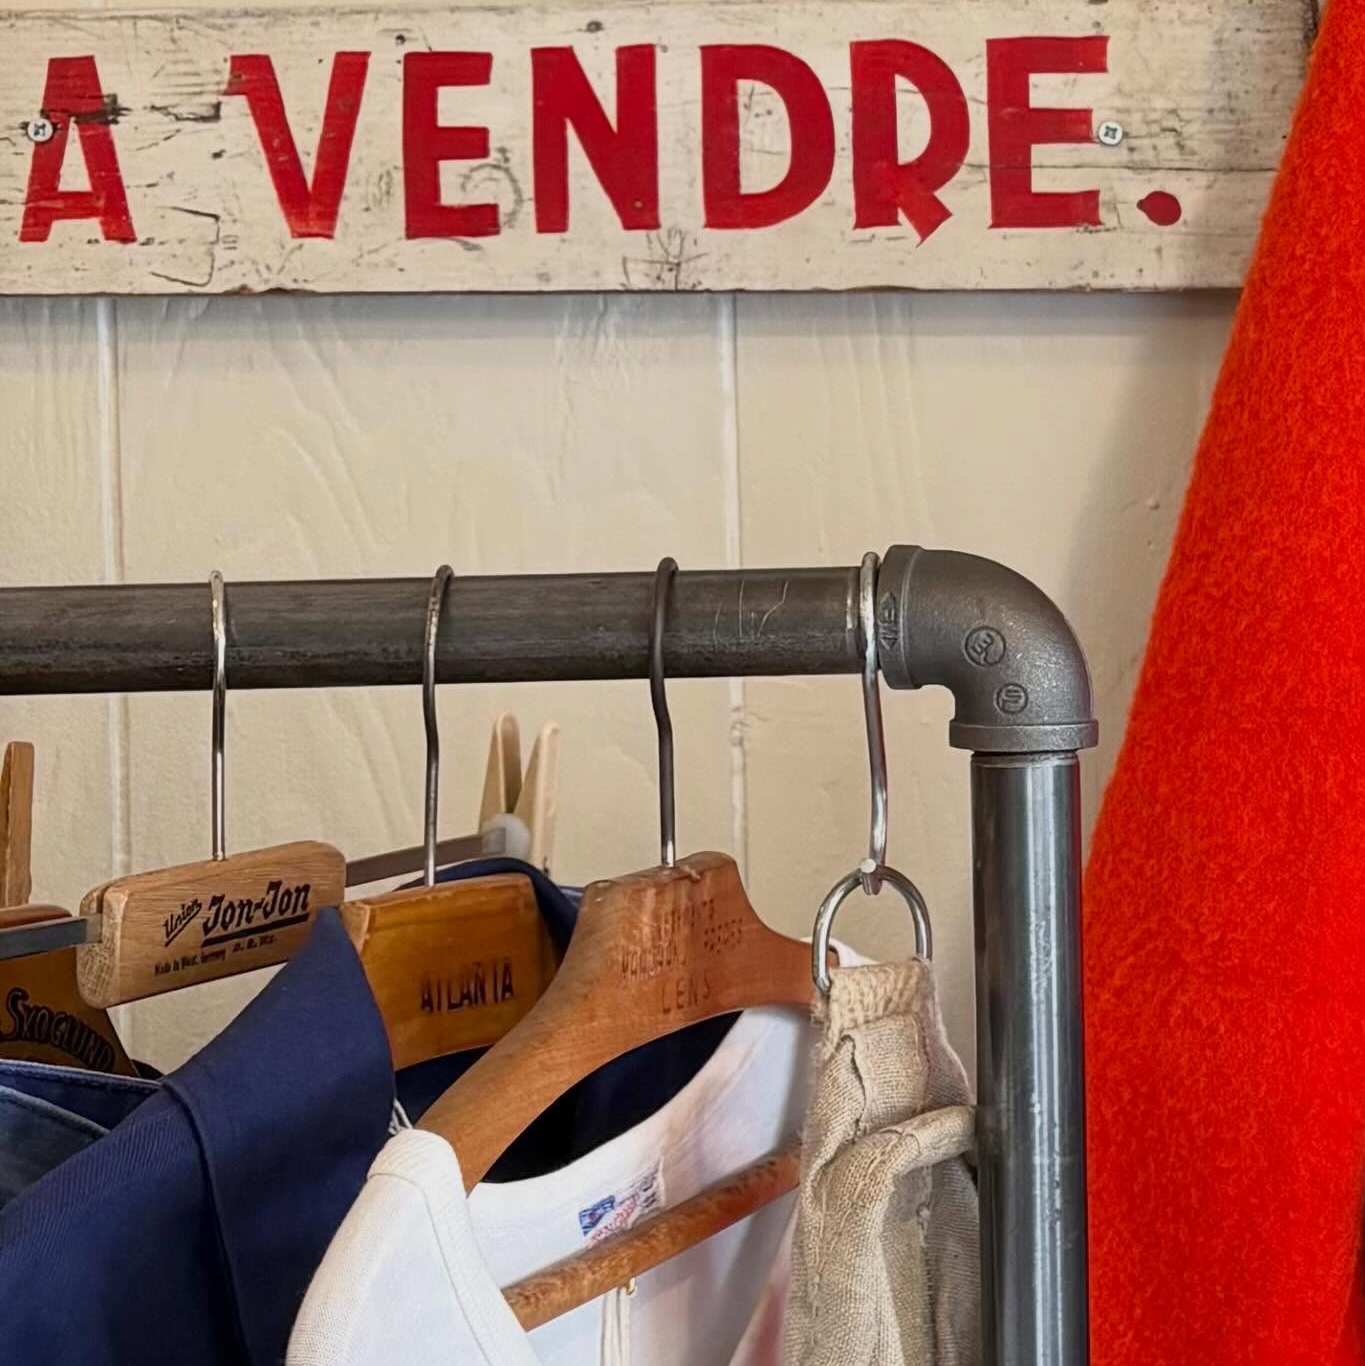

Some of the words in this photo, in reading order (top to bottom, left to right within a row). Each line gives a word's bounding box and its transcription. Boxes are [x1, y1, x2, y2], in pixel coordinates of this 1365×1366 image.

[20, 55, 136, 243] A
[222, 35, 1182, 248] VENDRE.
[163, 898, 202, 939] Union
[420, 958, 515, 1014] ATLANTA
